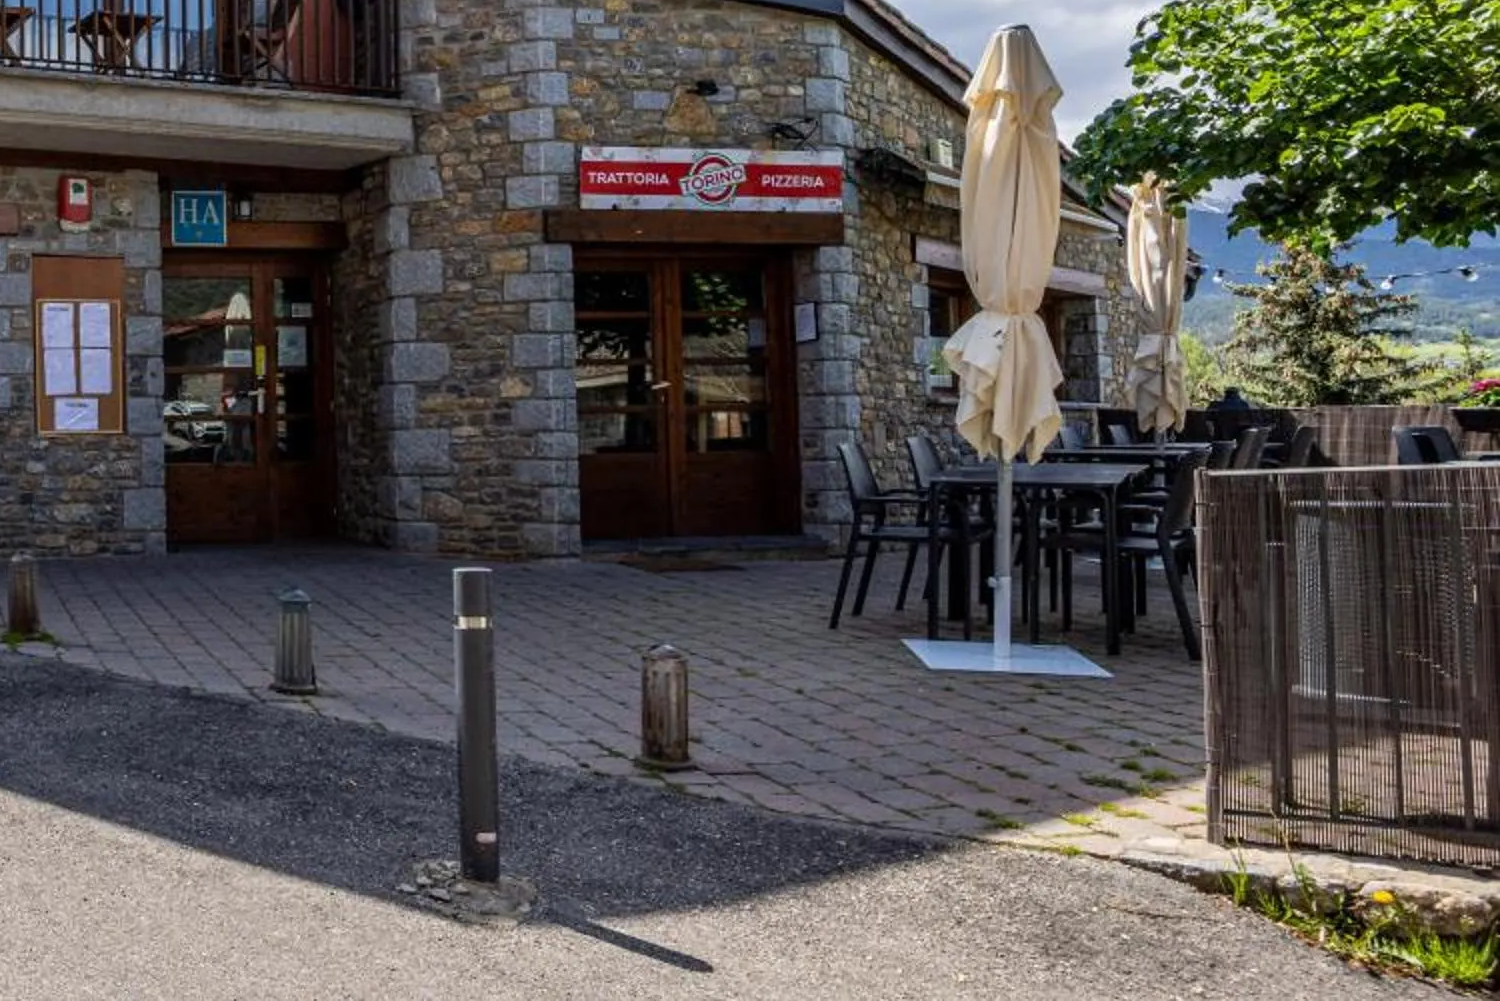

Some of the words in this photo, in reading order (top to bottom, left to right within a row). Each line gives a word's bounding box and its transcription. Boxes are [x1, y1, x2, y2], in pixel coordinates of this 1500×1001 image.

[588, 171, 669, 185] TRATTORIA
[681, 168, 743, 192] TORINO
[762, 173, 824, 189] PIZZERIA
[179, 198, 220, 225] HA
